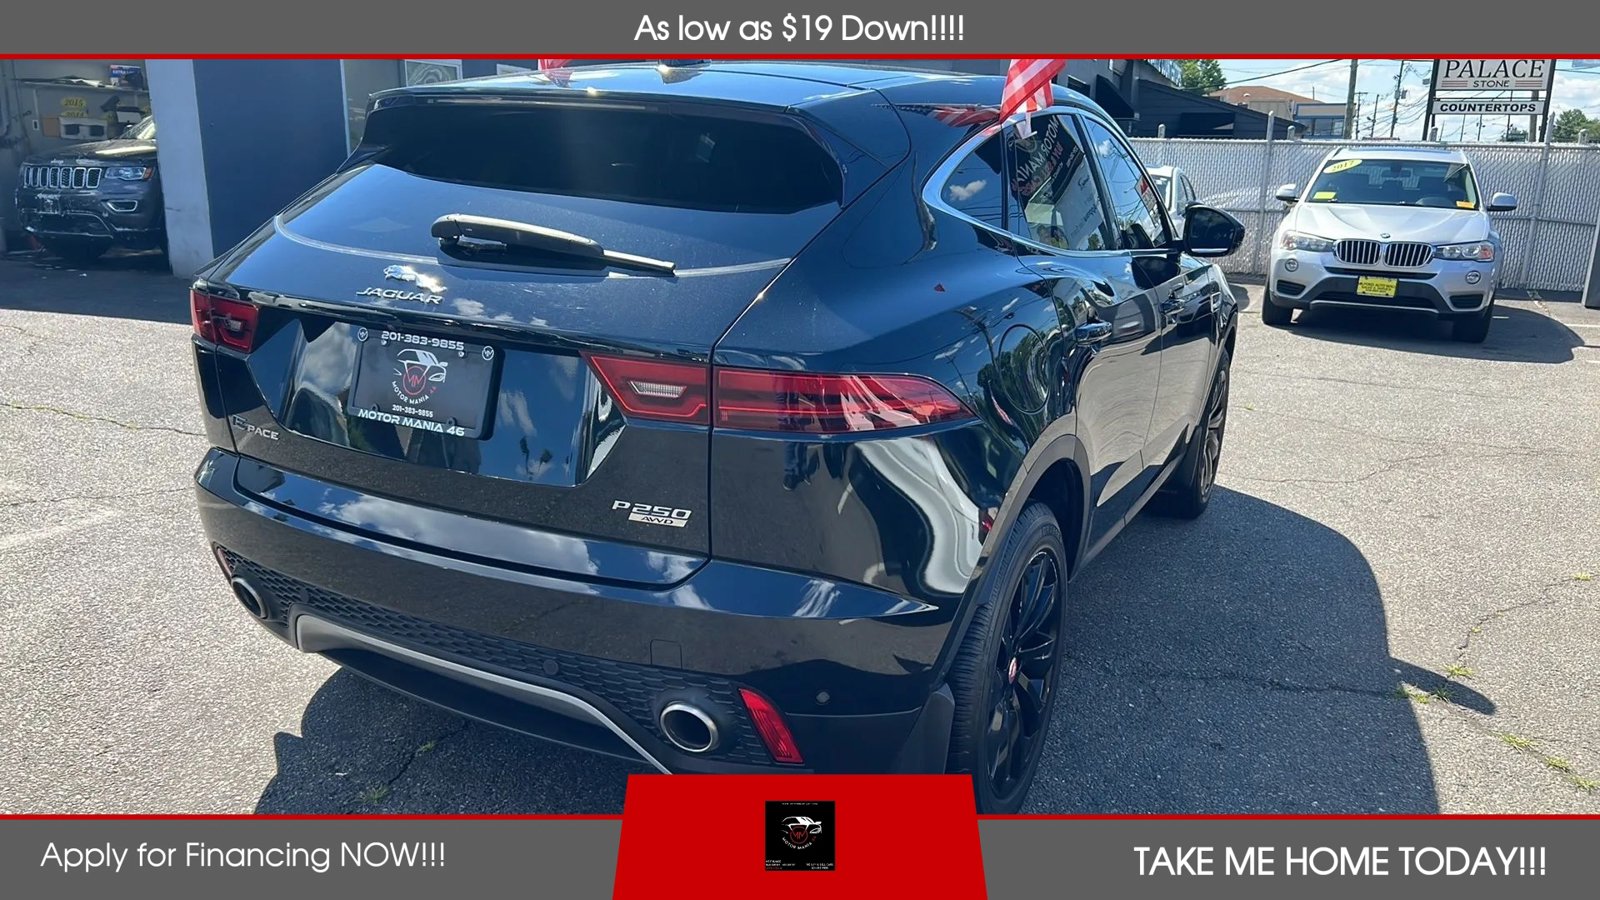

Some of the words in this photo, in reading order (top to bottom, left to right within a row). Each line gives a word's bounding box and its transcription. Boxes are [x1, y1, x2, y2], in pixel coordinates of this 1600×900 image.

[1444, 59, 1545, 79] PALACE
[1473, 80, 1510, 88] STONE
[1439, 103, 1536, 112] COUNTERTOPS
[1332, 160, 1355, 172] 2017
[356, 287, 444, 305] JAGUAR
[381, 331, 465, 351] 201-383-9855
[392, 380, 409, 402] MOTOR
[409, 394, 430, 405] MANIA
[358, 408, 401, 426] MOTOR
[402, 416, 445, 433] MANIA
[446, 427, 465, 437] 46
[611, 500, 692, 520] P250
[641, 516, 674, 525] AWD
